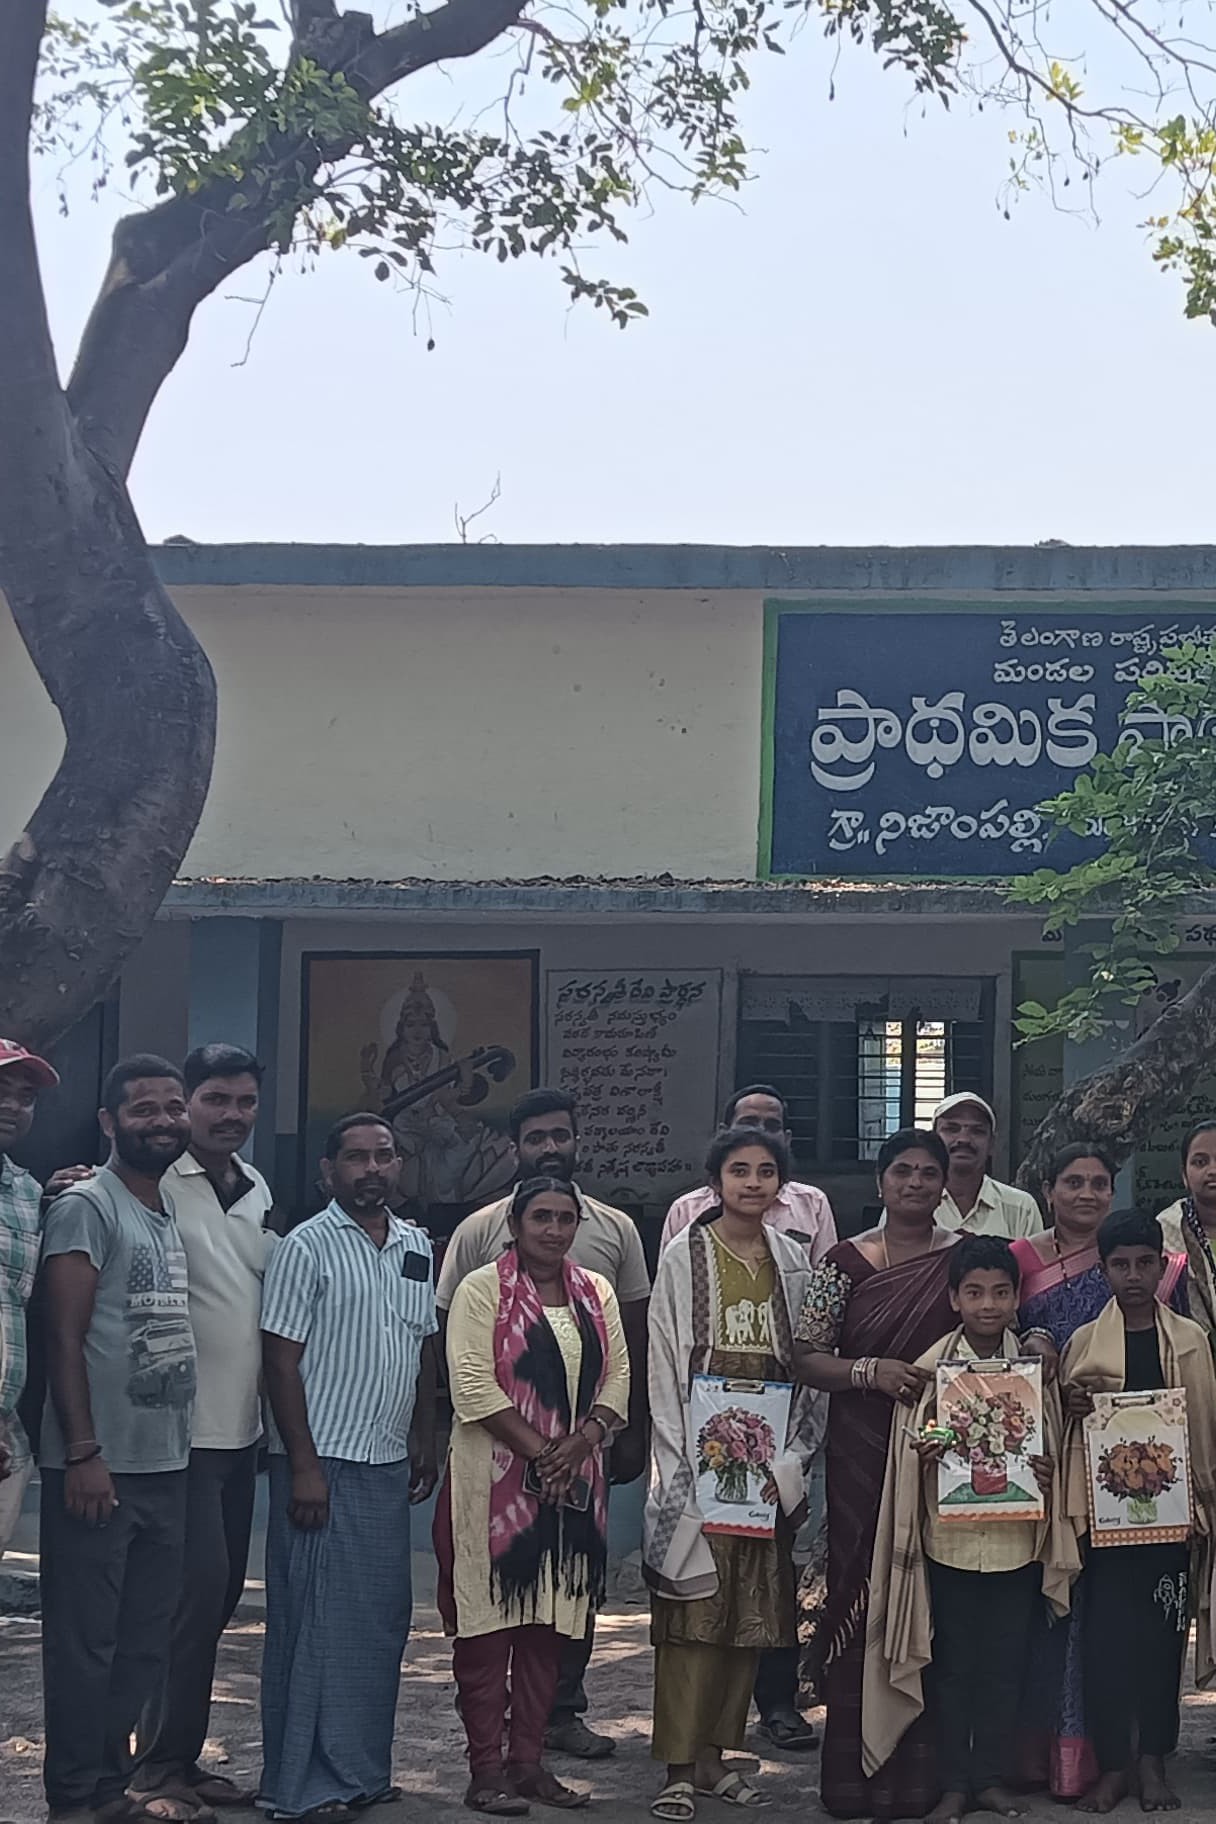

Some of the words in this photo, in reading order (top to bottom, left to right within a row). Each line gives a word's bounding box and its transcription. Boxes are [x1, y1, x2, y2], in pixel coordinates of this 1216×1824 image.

[1000, 619, 1103, 649] తెలంగాణ
[993, 658, 1094, 683] మండల
[810, 689, 1098, 791] ప్రాథమిక
